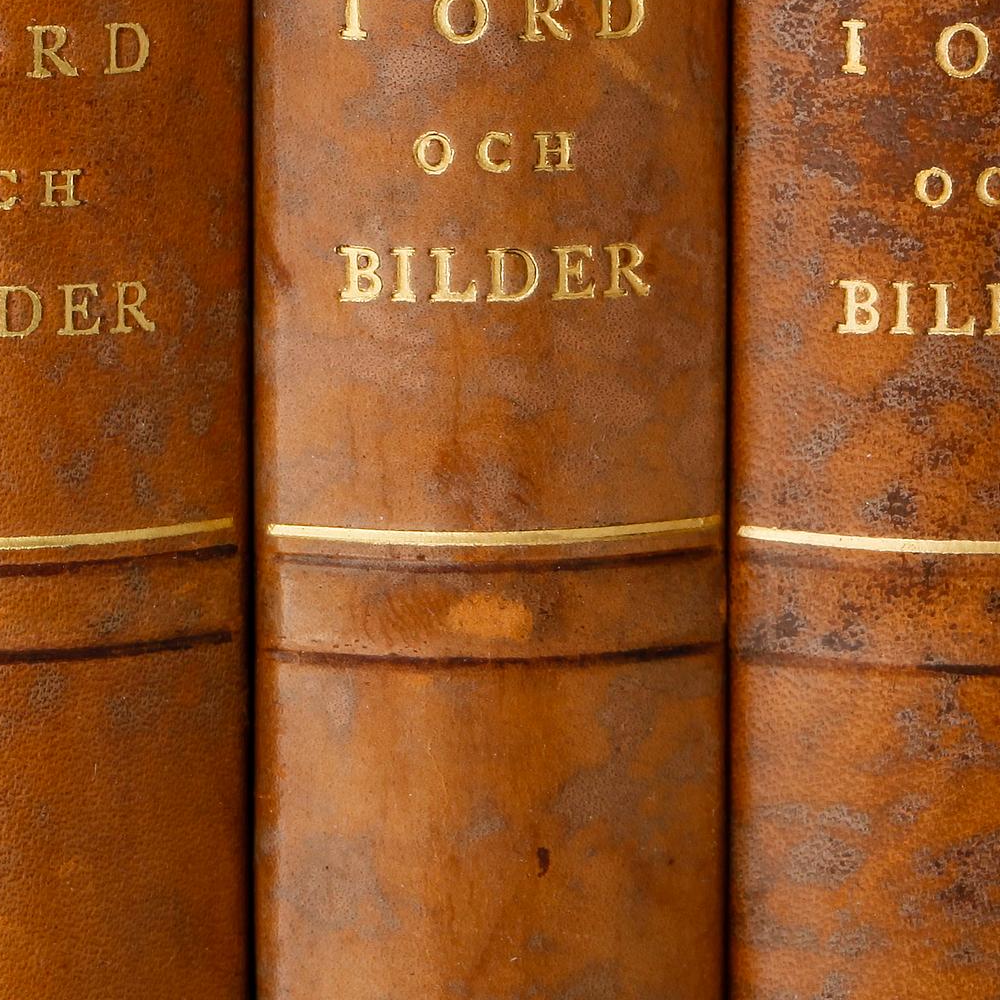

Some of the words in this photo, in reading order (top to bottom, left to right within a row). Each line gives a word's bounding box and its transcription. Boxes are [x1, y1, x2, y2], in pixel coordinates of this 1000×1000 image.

[840, 19, 867, 75] I
[413, 130, 576, 175] OCH
[338, 242, 652, 304] BILDER
